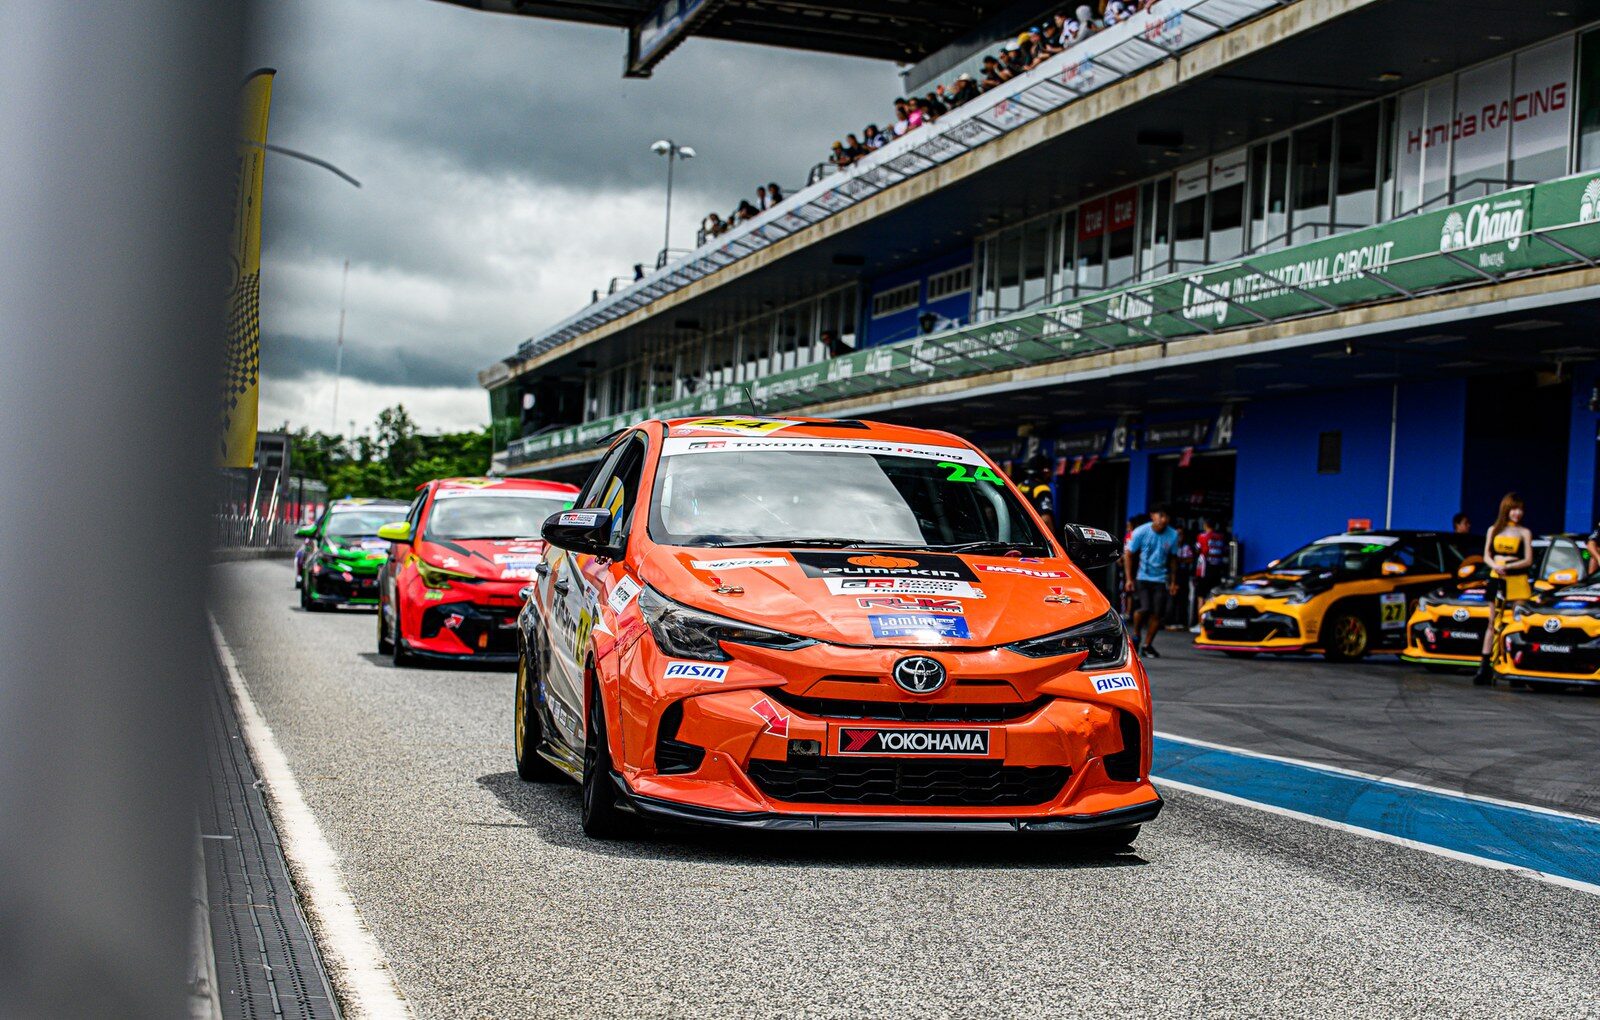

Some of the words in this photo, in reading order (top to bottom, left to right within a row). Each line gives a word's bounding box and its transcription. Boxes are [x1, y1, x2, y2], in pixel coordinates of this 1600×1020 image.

[1408, 111, 1477, 154] Honda
[1481, 82, 1566, 131] RACING
[1465, 202, 1524, 252] Chang
[1182, 277, 1230, 323] Chang
[1232, 257, 1331, 304] INTERNATIONAL
[1332, 241, 1395, 284] CIRCUIT
[1216, 415, 1233, 444] 14
[820, 442, 893, 452] GAZOO
[897, 447, 963, 461] Racing
[937, 462, 1005, 486] 24
[986, 566, 1062, 578] MOTUL
[1385, 604, 1401, 620] 27
[667, 664, 725, 679] AISIN
[1096, 676, 1137, 690] AISIN
[878, 732, 985, 751] YOKOHAMA
